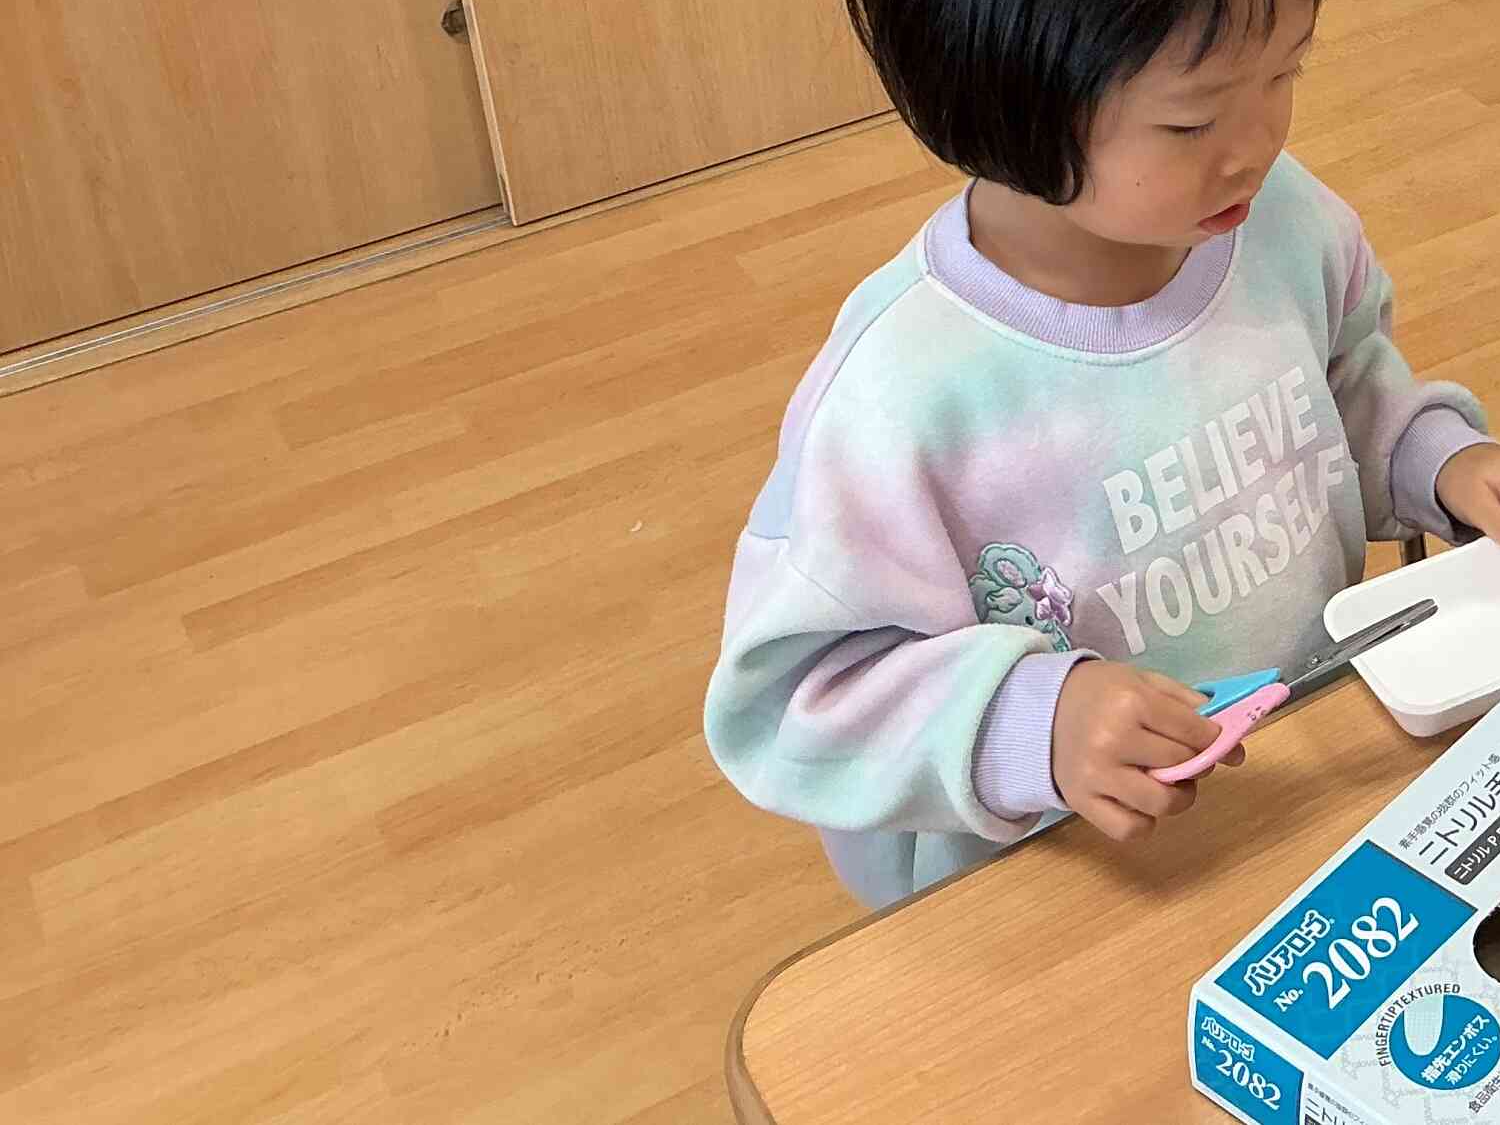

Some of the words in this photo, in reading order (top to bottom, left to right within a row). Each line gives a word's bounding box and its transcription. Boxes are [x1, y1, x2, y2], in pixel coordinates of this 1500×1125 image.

[1103, 366, 1318, 556] BELIEVE
[1096, 442, 1346, 656] YOURSELF
[1452, 843, 1491, 880] ニトリル
[1273, 987, 1305, 1013] No.
[1302, 897, 1420, 1010] 2082
[1214, 1049, 1282, 1112] 2082
[1420, 1014, 1491, 1084] 指先エンボス
[1444, 1035, 1499, 1086] 滑りにくい。
